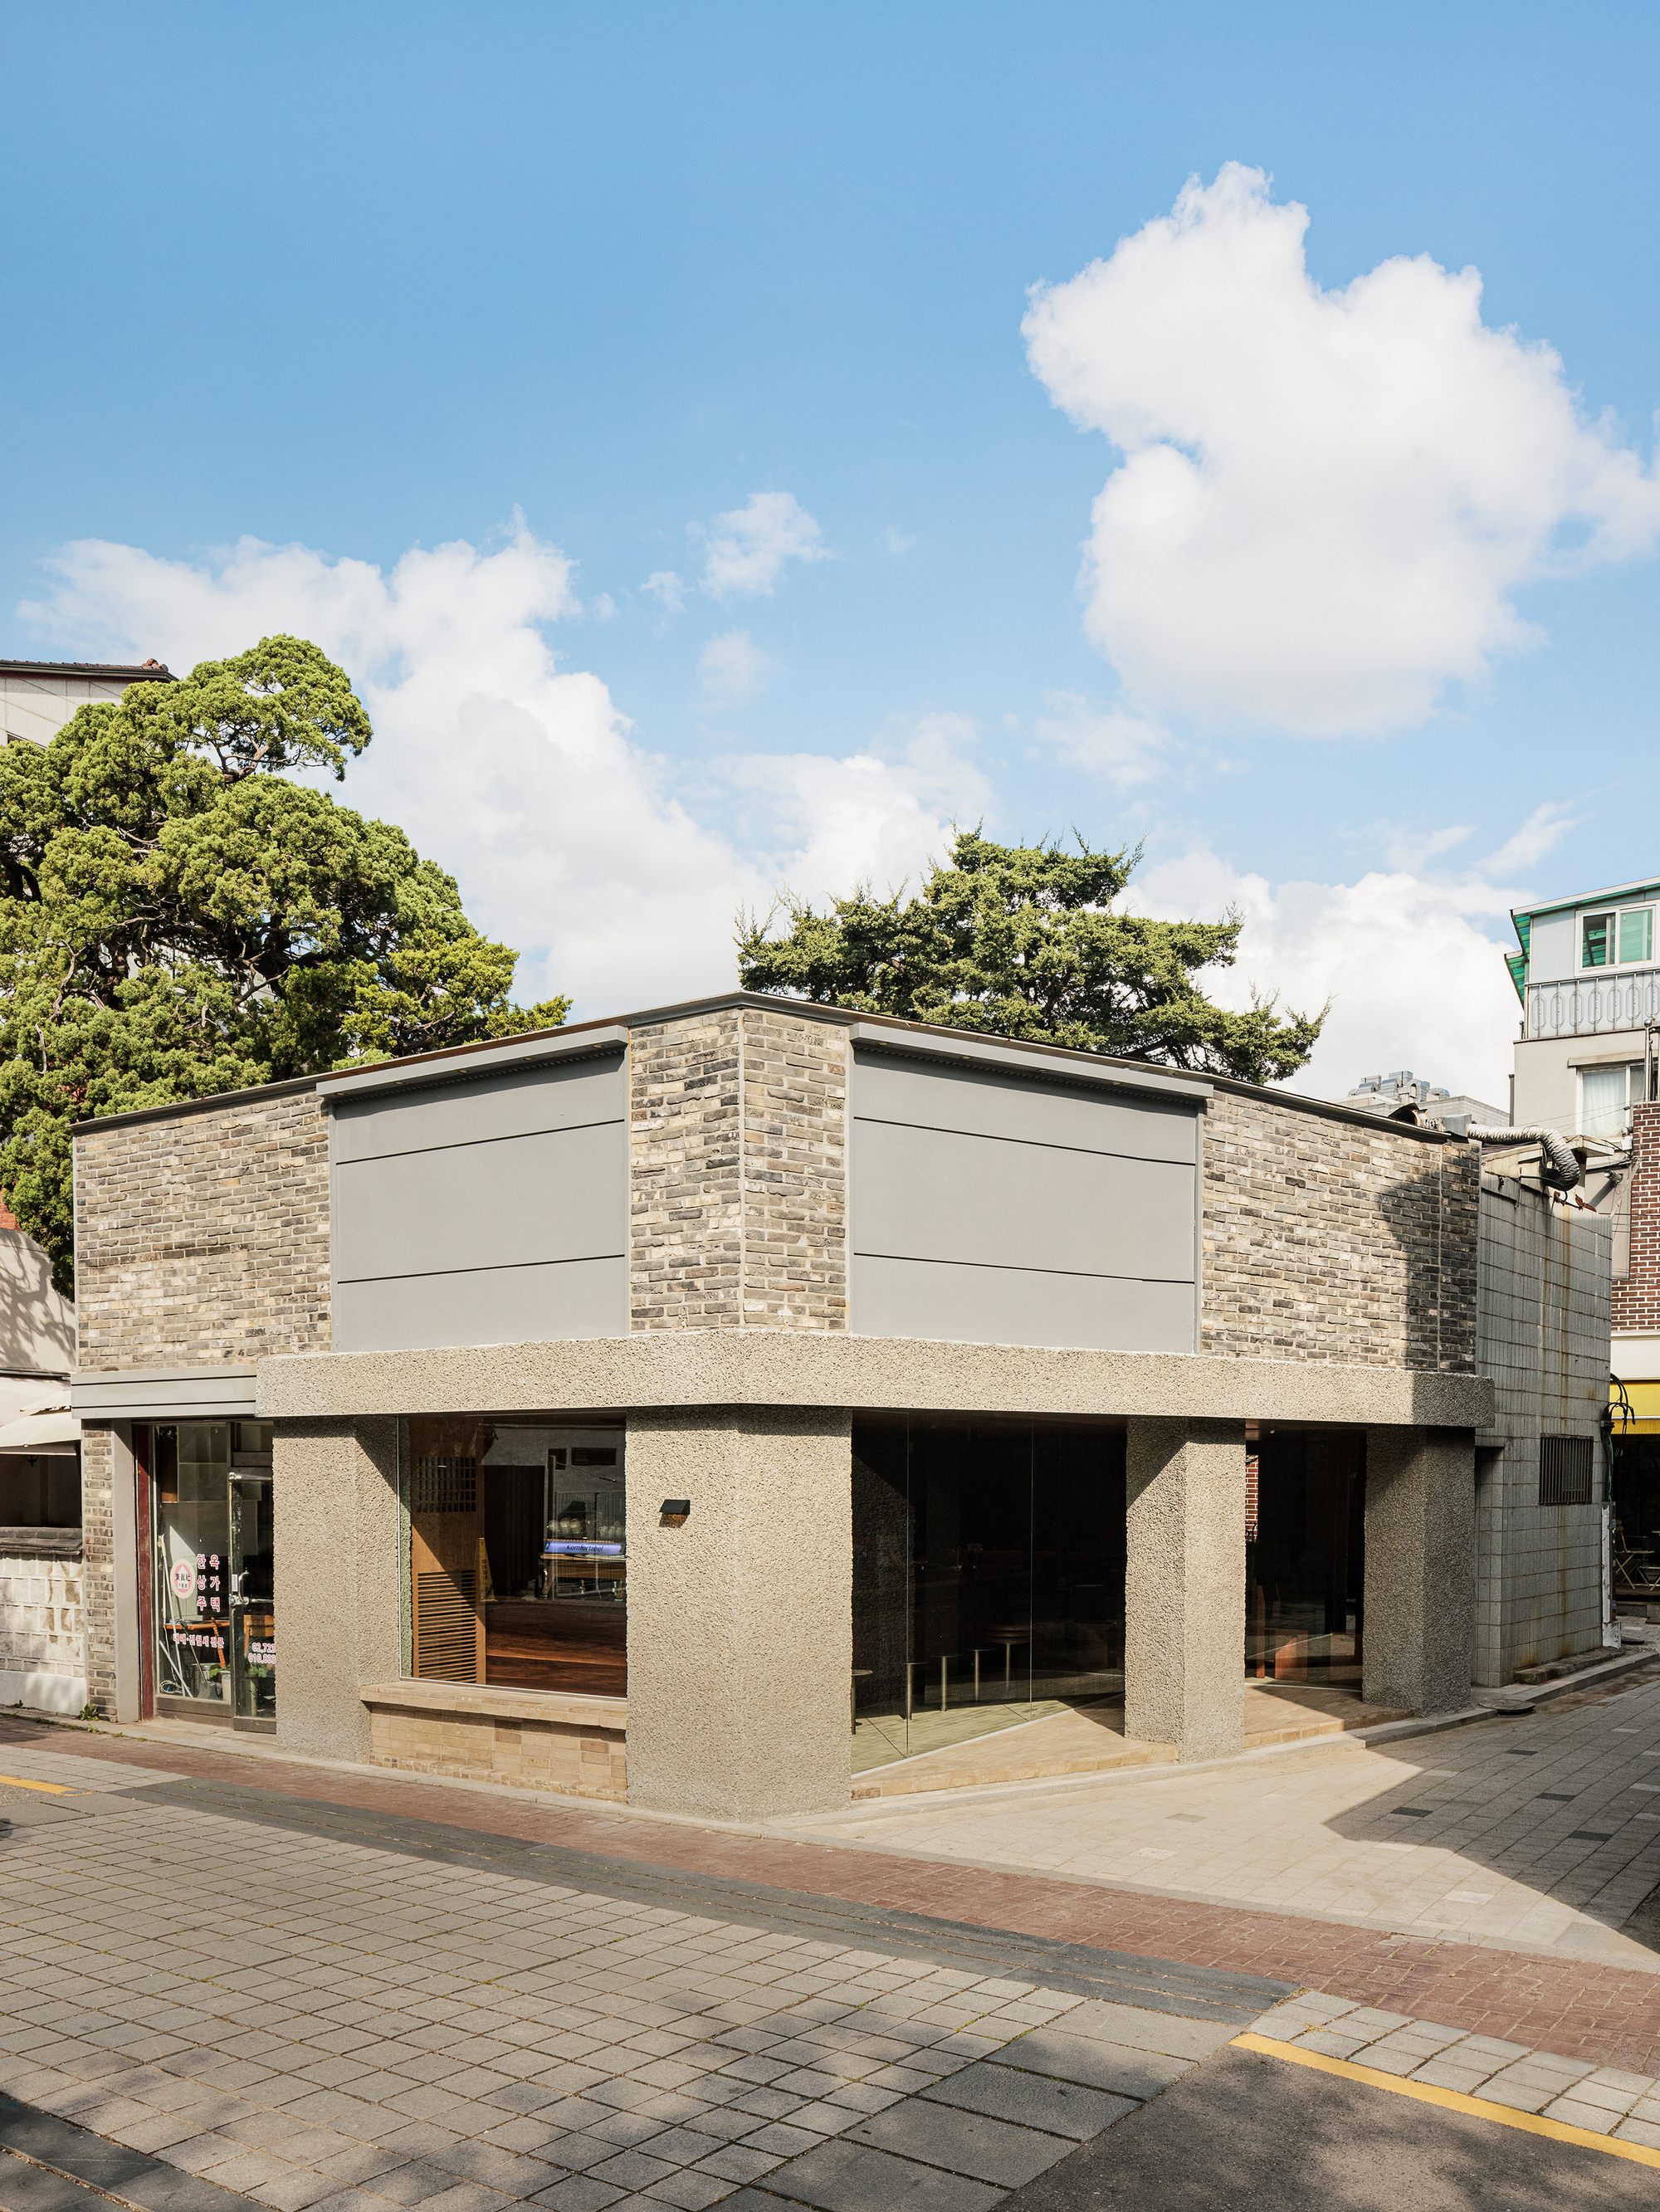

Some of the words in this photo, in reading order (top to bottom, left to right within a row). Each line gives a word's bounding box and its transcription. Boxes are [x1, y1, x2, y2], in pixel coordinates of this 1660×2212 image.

[566, 1544, 603, 1552] Komfortabel
[197, 1554, 220, 1570] 한옥
[197, 1575, 220, 1591] 상가
[197, 1596, 220, 1612] 주택
[210, 1636, 224, 1648] 전문
